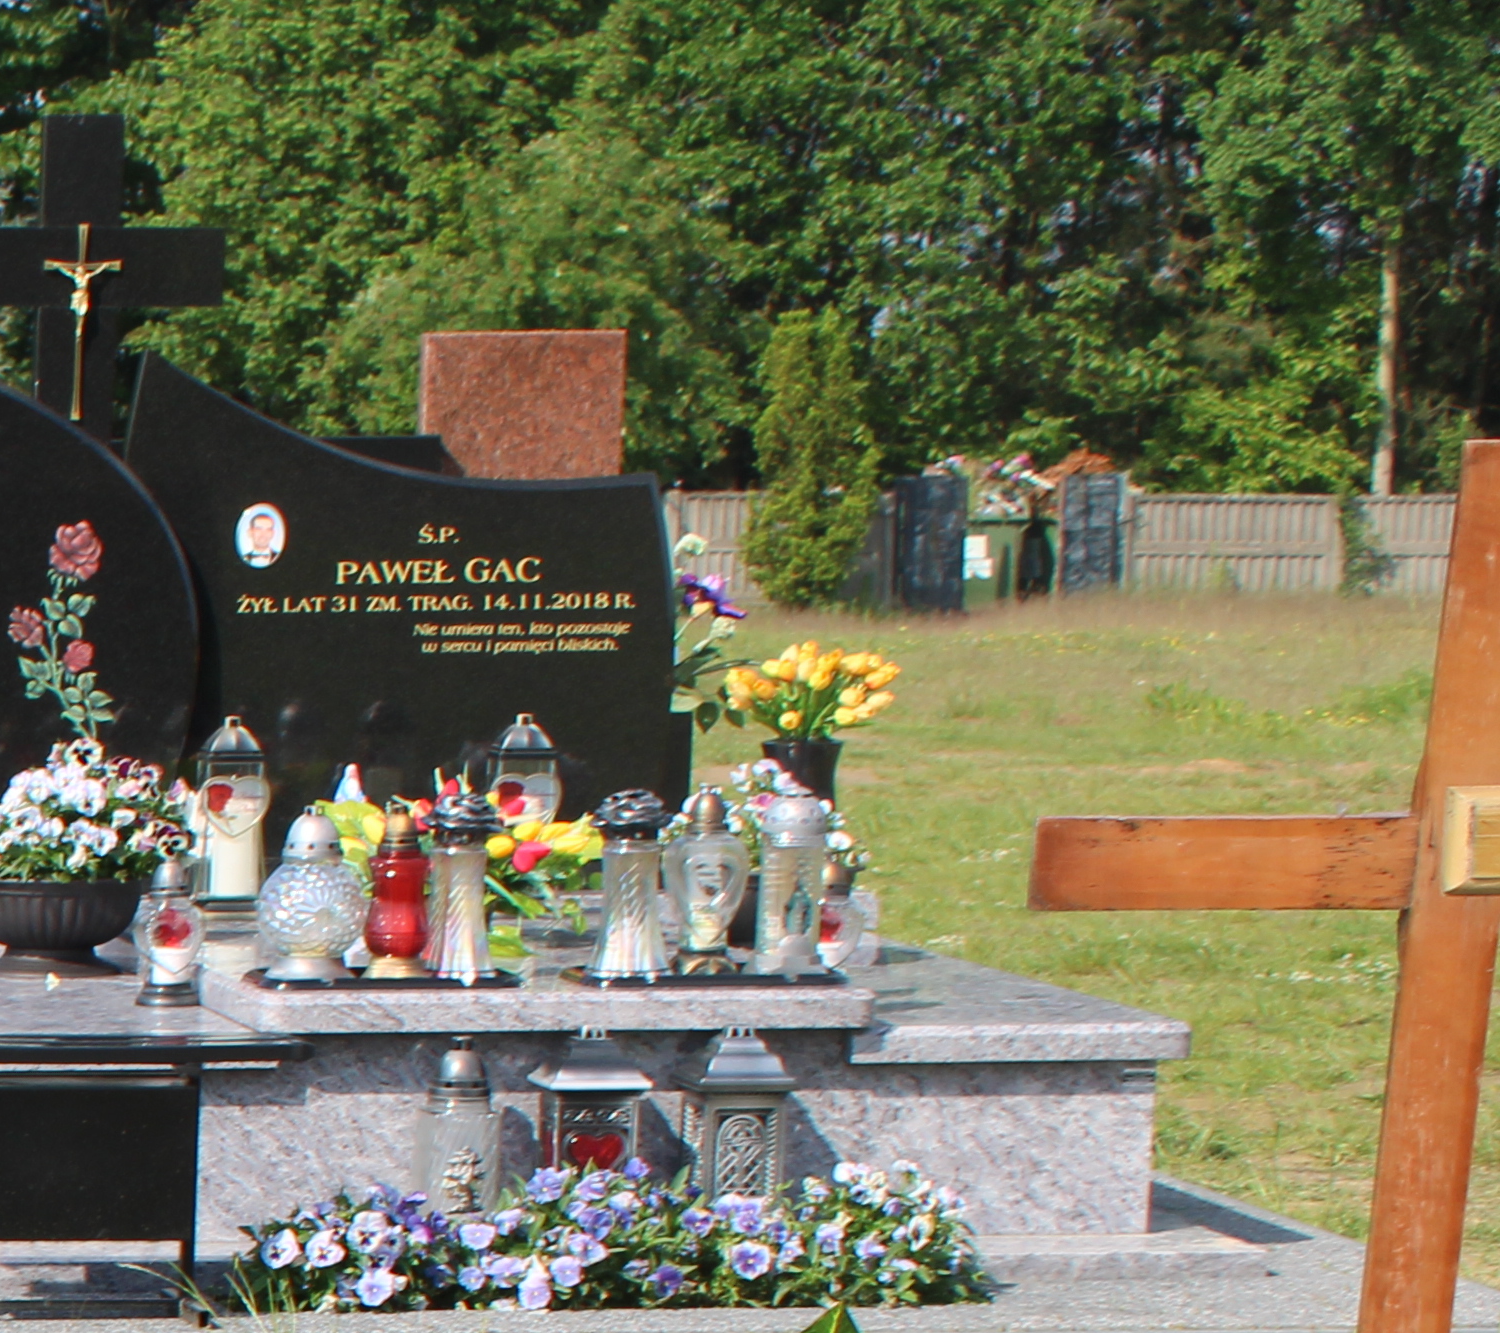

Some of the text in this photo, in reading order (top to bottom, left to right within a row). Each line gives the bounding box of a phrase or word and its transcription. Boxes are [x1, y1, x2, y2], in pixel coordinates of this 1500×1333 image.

[418, 524, 460, 543] Ś.P.
[335, 556, 542, 585] PAWEŁ GAC
[237, 592, 637, 613] ŻYŁ LAT 31 ZM. TRAG. 14.11.2018 R.
[441, 623, 494, 636] umiera
[555, 620, 632, 638] pozostaje
